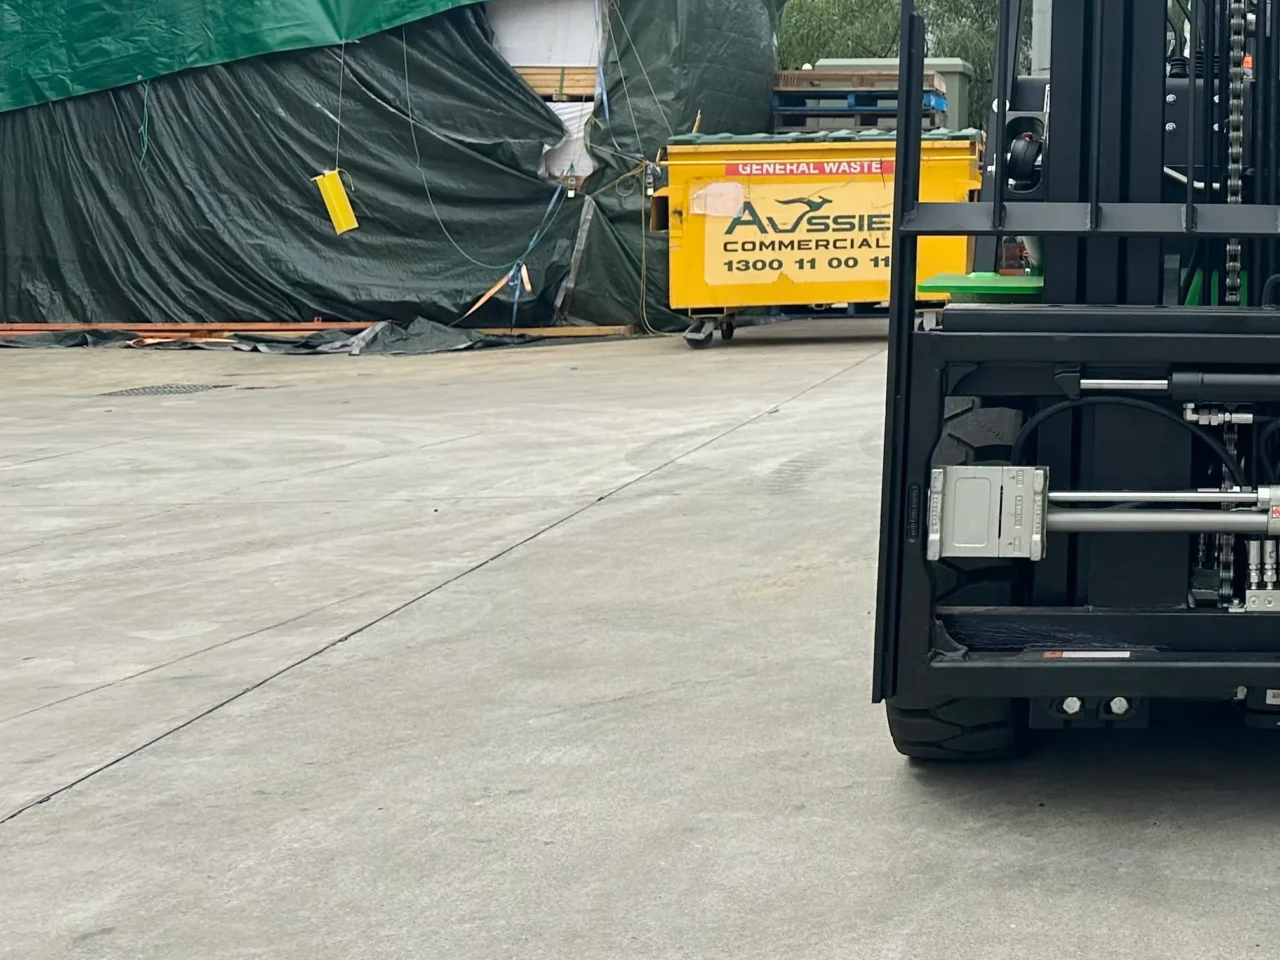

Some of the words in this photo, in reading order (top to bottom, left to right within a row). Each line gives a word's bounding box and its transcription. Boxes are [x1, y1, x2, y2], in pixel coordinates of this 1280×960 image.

[738, 162, 818, 174] GENERAL
[824, 161, 882, 174] WASTE
[724, 197, 891, 235] AUSSIE
[723, 238, 890, 252] COMMERCIAL
[723, 258, 783, 272] 1300
[794, 257, 816, 270] 11
[828, 256, 859, 269] 00
[870, 255, 890, 268] 11
